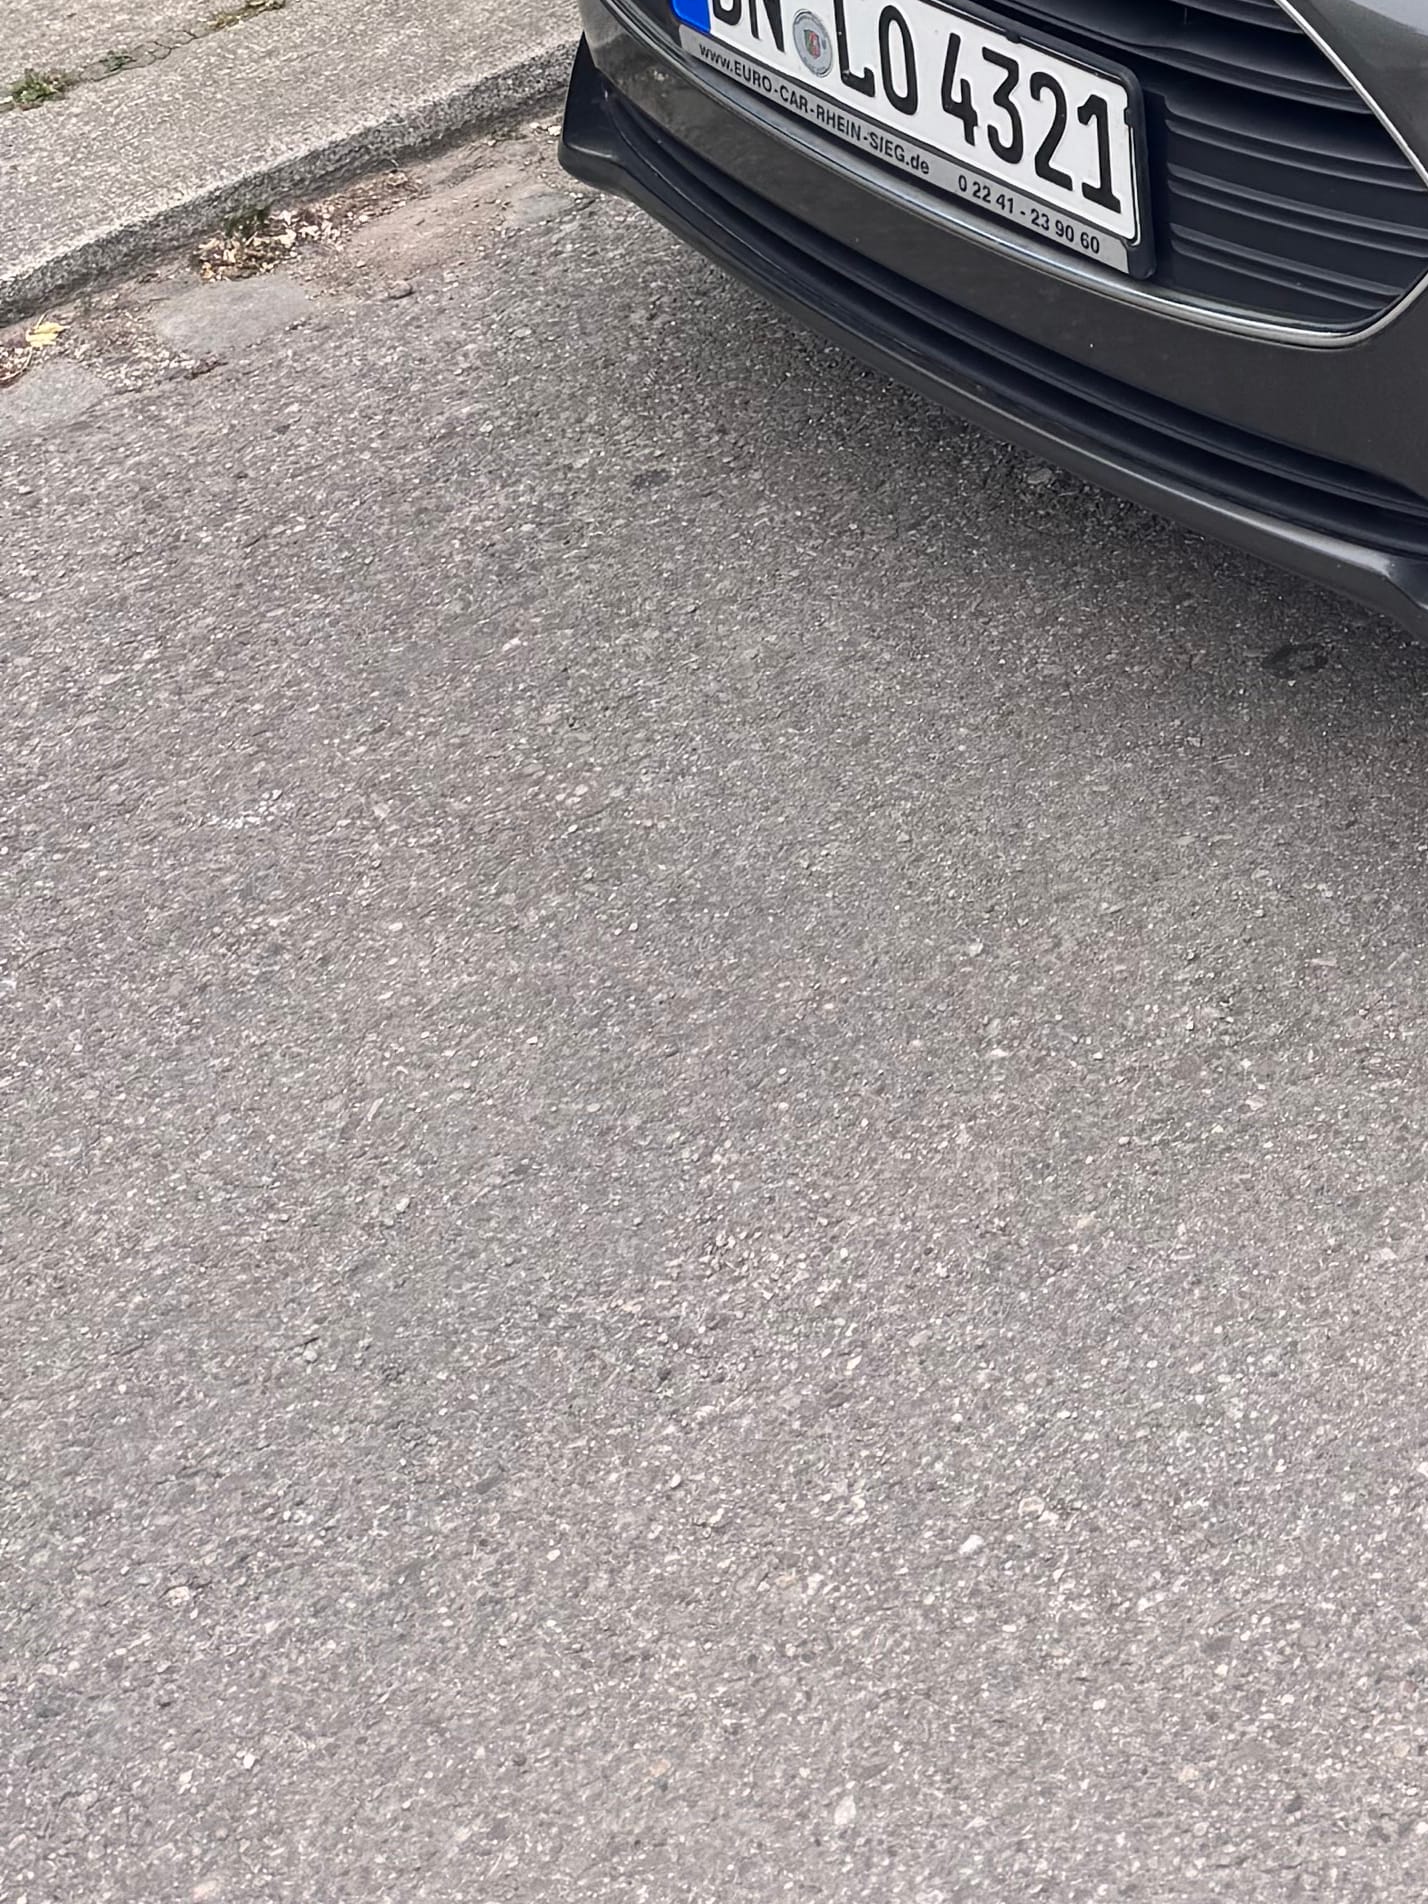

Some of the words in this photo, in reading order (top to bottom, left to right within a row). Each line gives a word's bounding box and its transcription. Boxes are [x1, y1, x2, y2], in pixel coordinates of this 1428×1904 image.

[699, 43, 930, 175] www.EURO-CAR-RHEIN-SIEG.de
[958, 174, 967, 192] 0
[972, 181, 991, 204] 22
[996, 193, 1014, 214] 41
[1030, 208, 1050, 231] 23
[1055, 219, 1075, 243] 90
[1080, 231, 1100, 254] 60
[940, 32, 1122, 215] 4321
